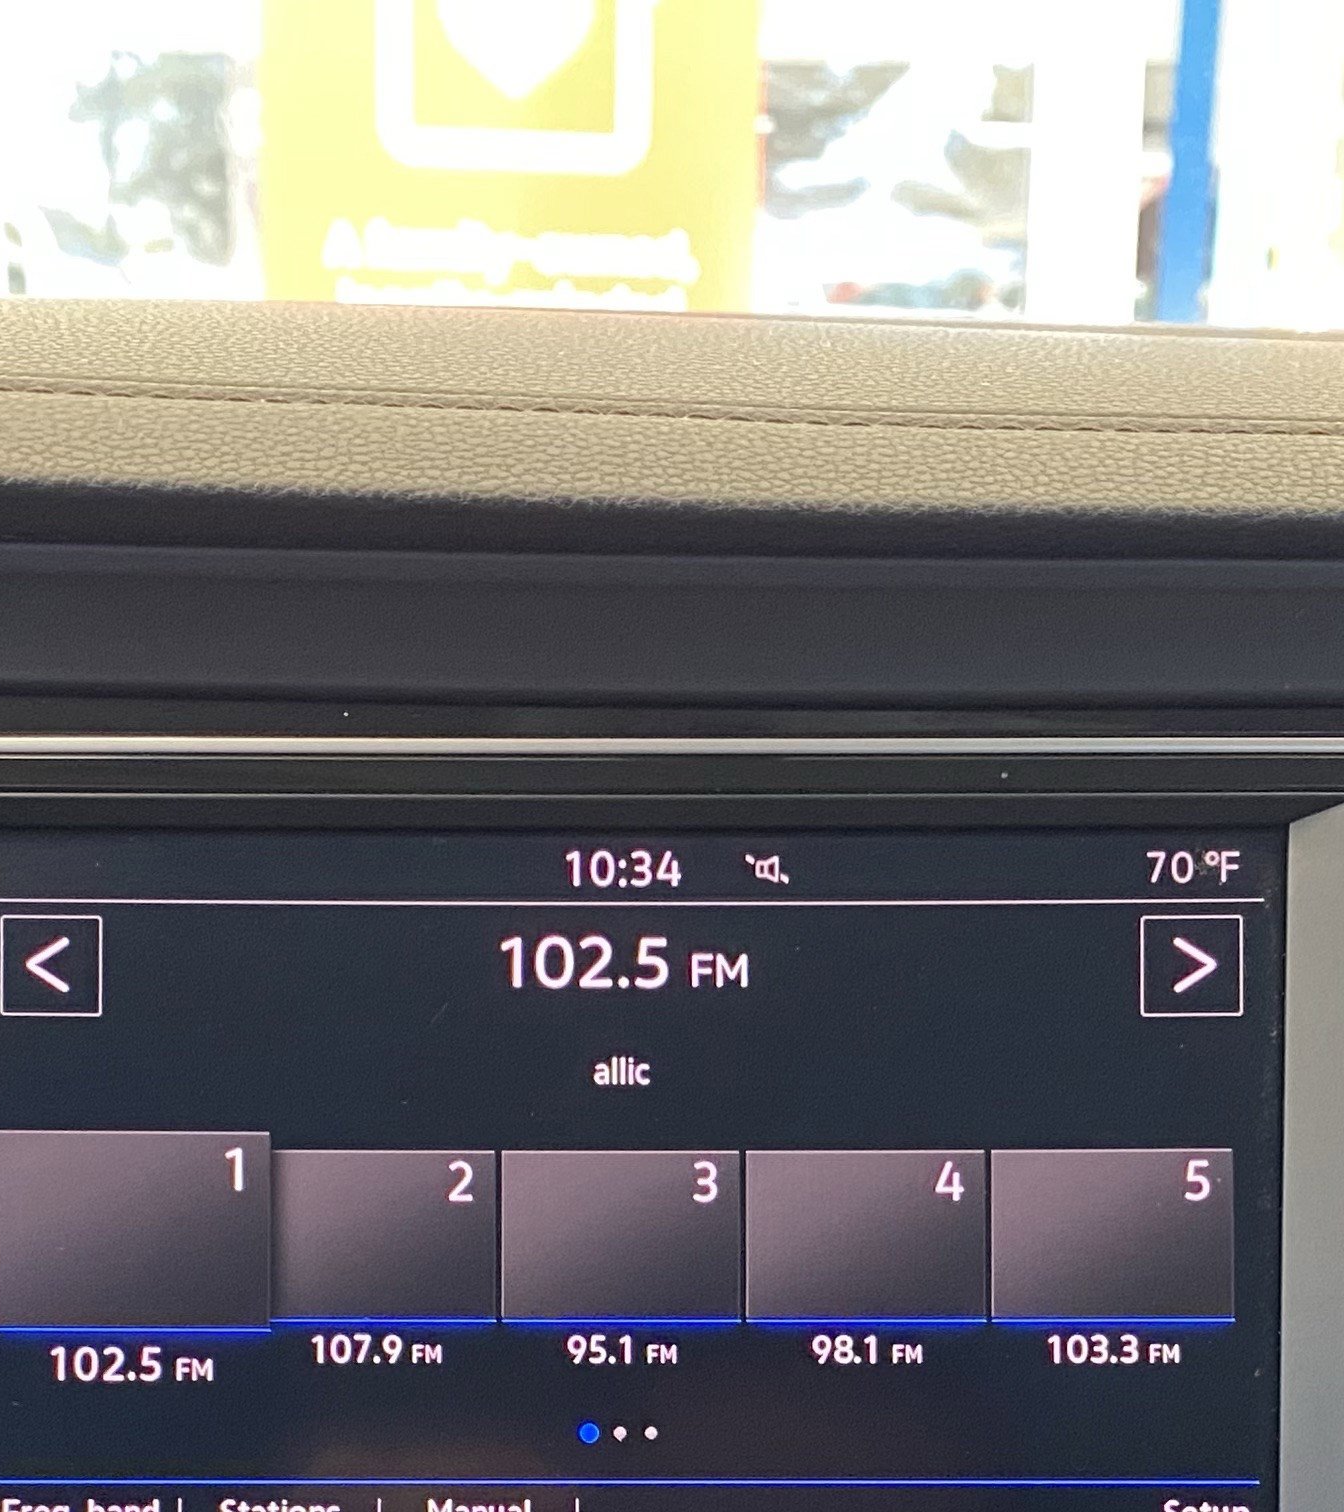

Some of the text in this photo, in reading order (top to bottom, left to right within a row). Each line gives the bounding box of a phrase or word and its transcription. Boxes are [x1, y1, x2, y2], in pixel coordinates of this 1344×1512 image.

[564, 848, 683, 889] 10:34
[499, 933, 750, 991] 102.5 FM
[592, 1054, 652, 1087] allic
[223, 1146, 245, 1193] 1
[447, 1159, 475, 1203] 2
[691, 1159, 719, 1205] 3
[934, 1159, 966, 1203] 4
[1183, 1158, 1212, 1203] 5
[49, 1344, 215, 1383] 102.5 FM
[310, 1331, 444, 1365] 107.9 FM
[565, 1333, 679, 1366] 95.1 FM
[810, 1333, 925, 1366] 98.1 FM
[1046, 1332, 1182, 1366] 103.3 FM
